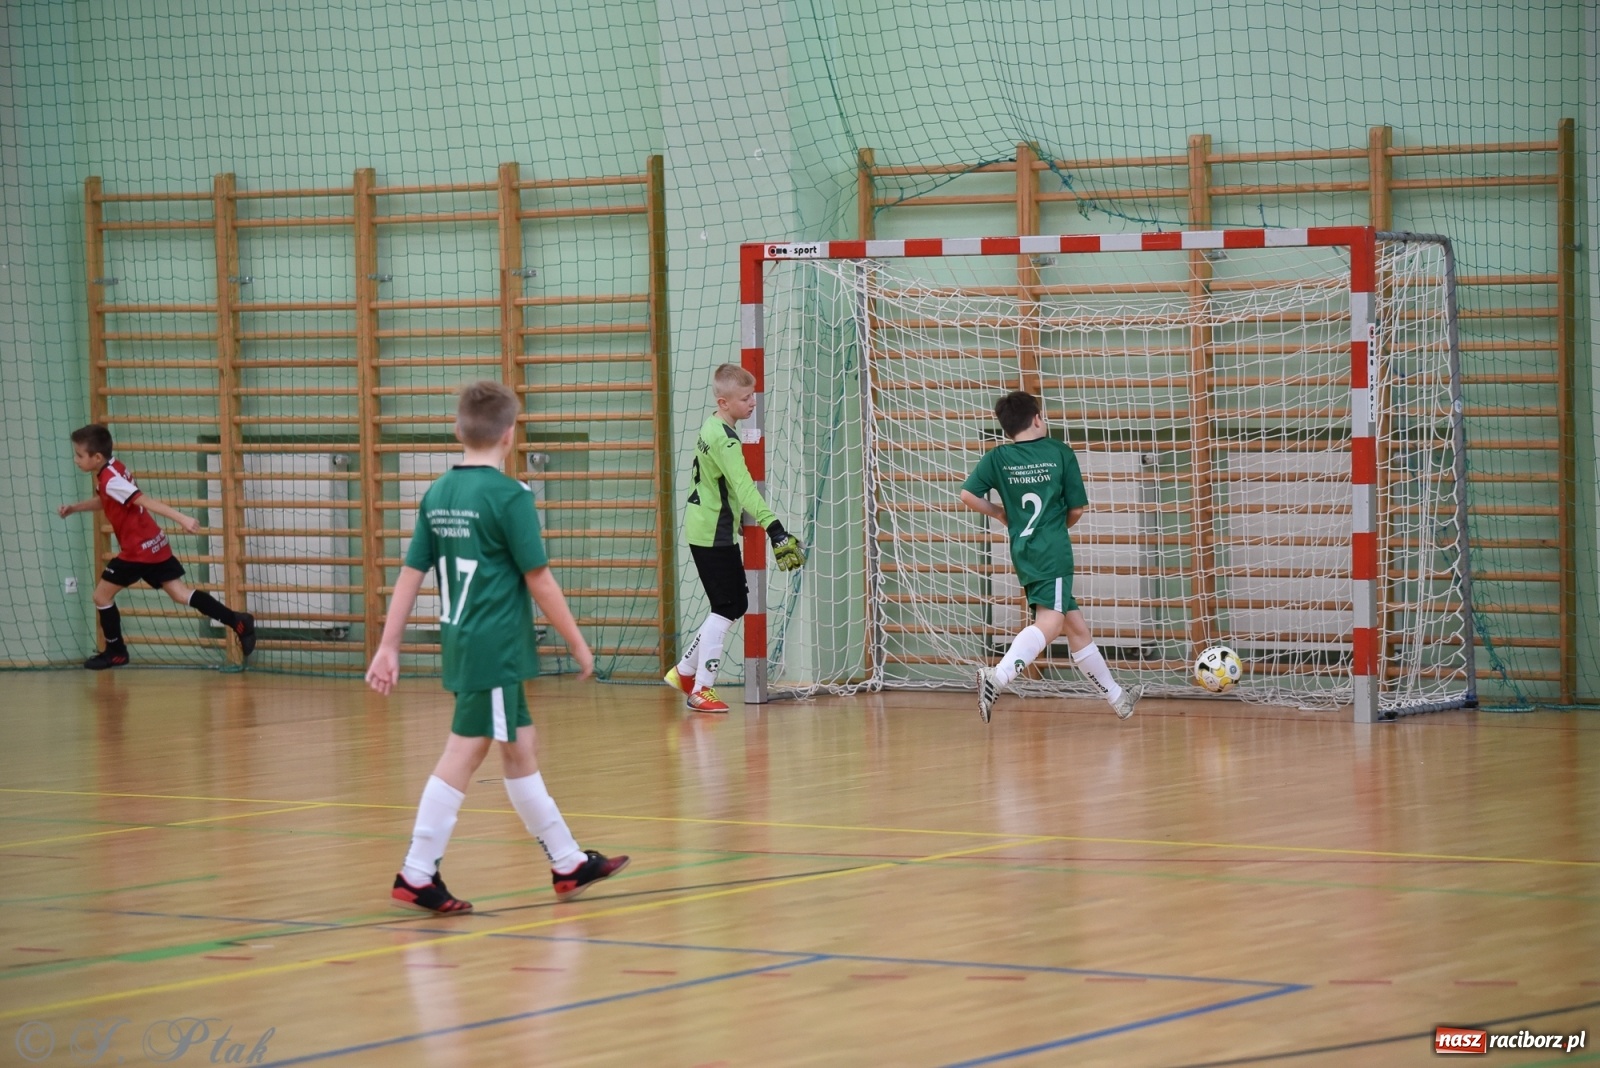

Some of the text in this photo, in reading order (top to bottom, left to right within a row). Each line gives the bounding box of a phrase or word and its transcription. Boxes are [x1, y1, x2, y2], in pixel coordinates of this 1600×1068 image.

[794, 245, 817, 257] sport
[1008, 473, 1051, 484] TWORKÓW
[1020, 493, 1042, 537] 2
[439, 556, 478, 625] 17
